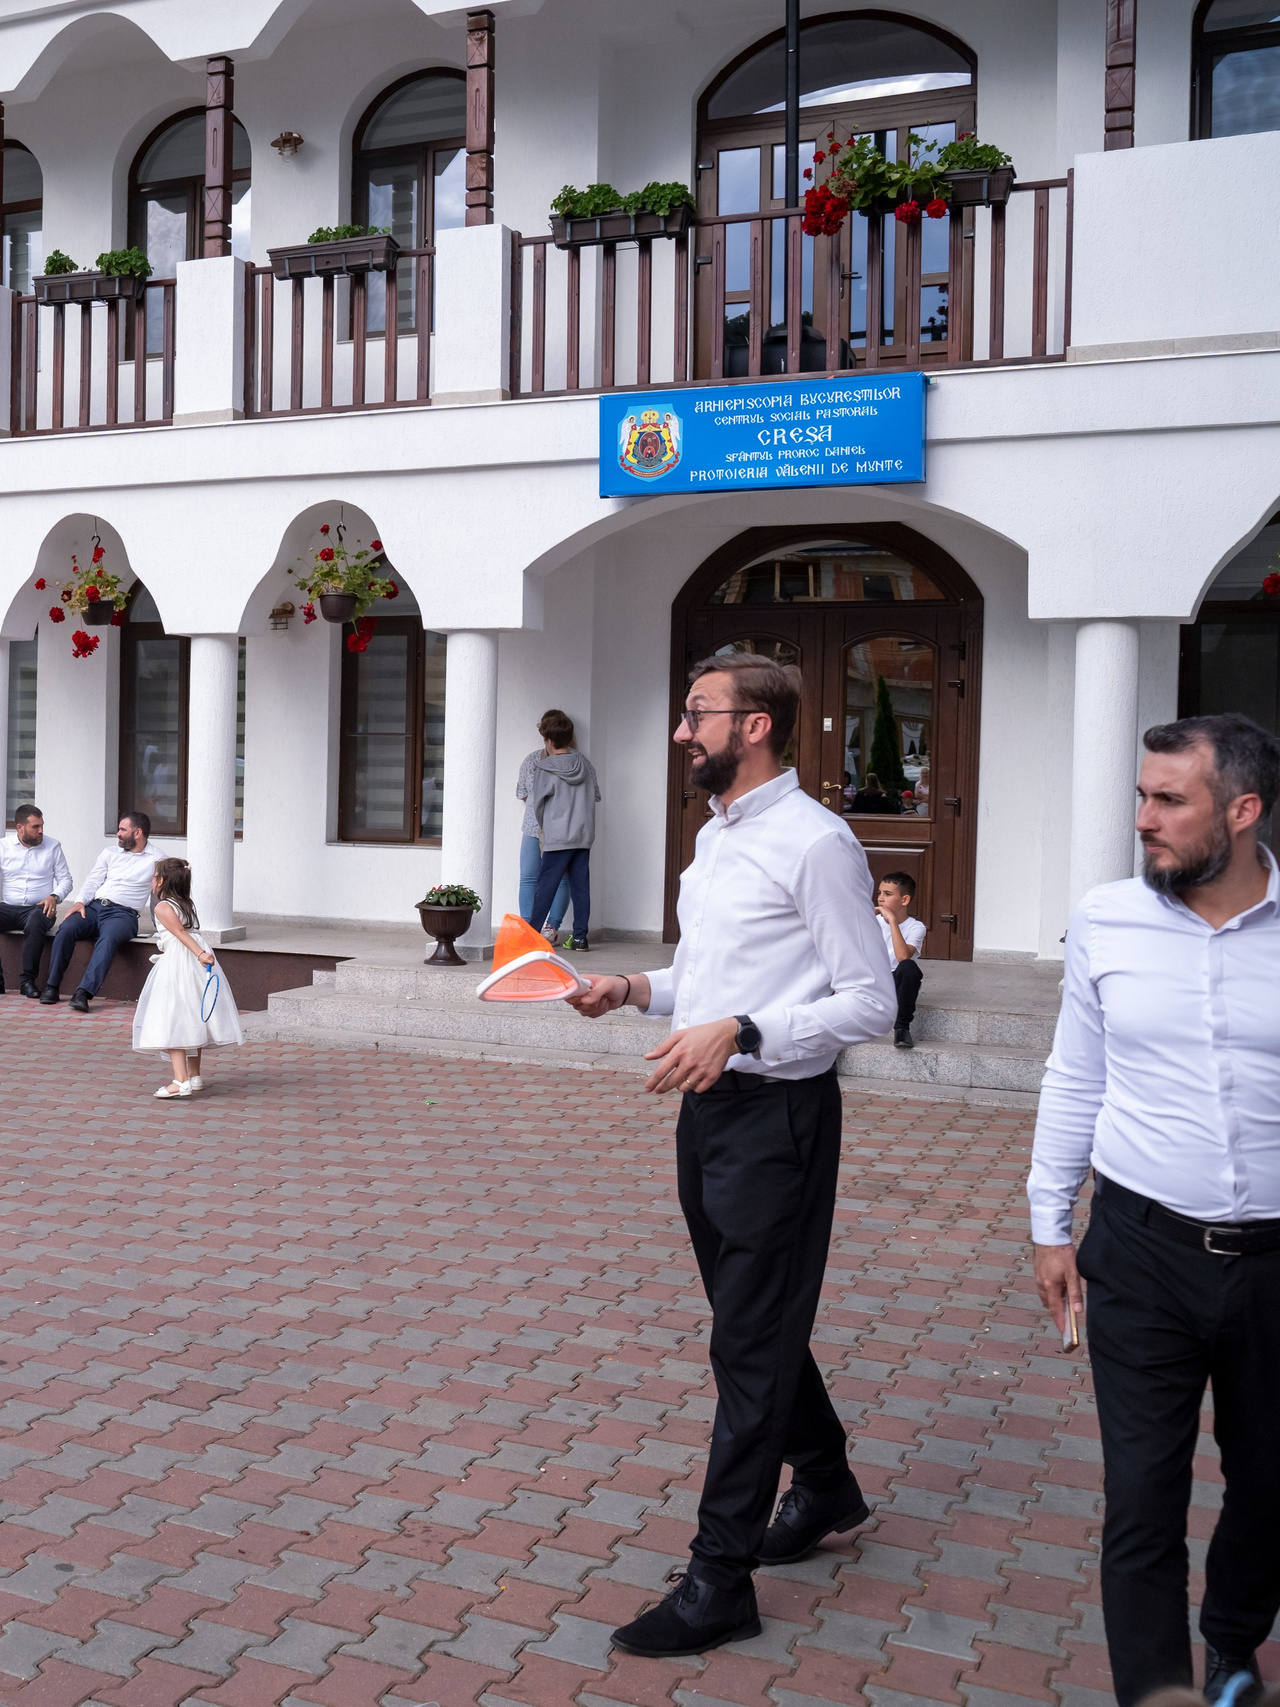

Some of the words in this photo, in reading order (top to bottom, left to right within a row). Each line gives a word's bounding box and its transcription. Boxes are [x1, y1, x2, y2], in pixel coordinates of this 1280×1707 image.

[694, 395, 793, 413] ARHIEPISCOPIA
[714, 414, 764, 426] CENTRUL
[770, 410, 811, 422] SOCIAL
[816, 406, 878, 419] PASTORAL
[757, 425, 832, 446] CREȘA
[725, 451, 773, 462] SFÂNTUL
[778, 448, 820, 460] PROROC
[825, 446, 866, 457] DANIEL
[690, 466, 768, 482] PROTOIERIA
[776, 463, 824, 477] VĂLENII
[831, 462, 849, 474] DE
[856, 459, 904, 473] MUNTE
